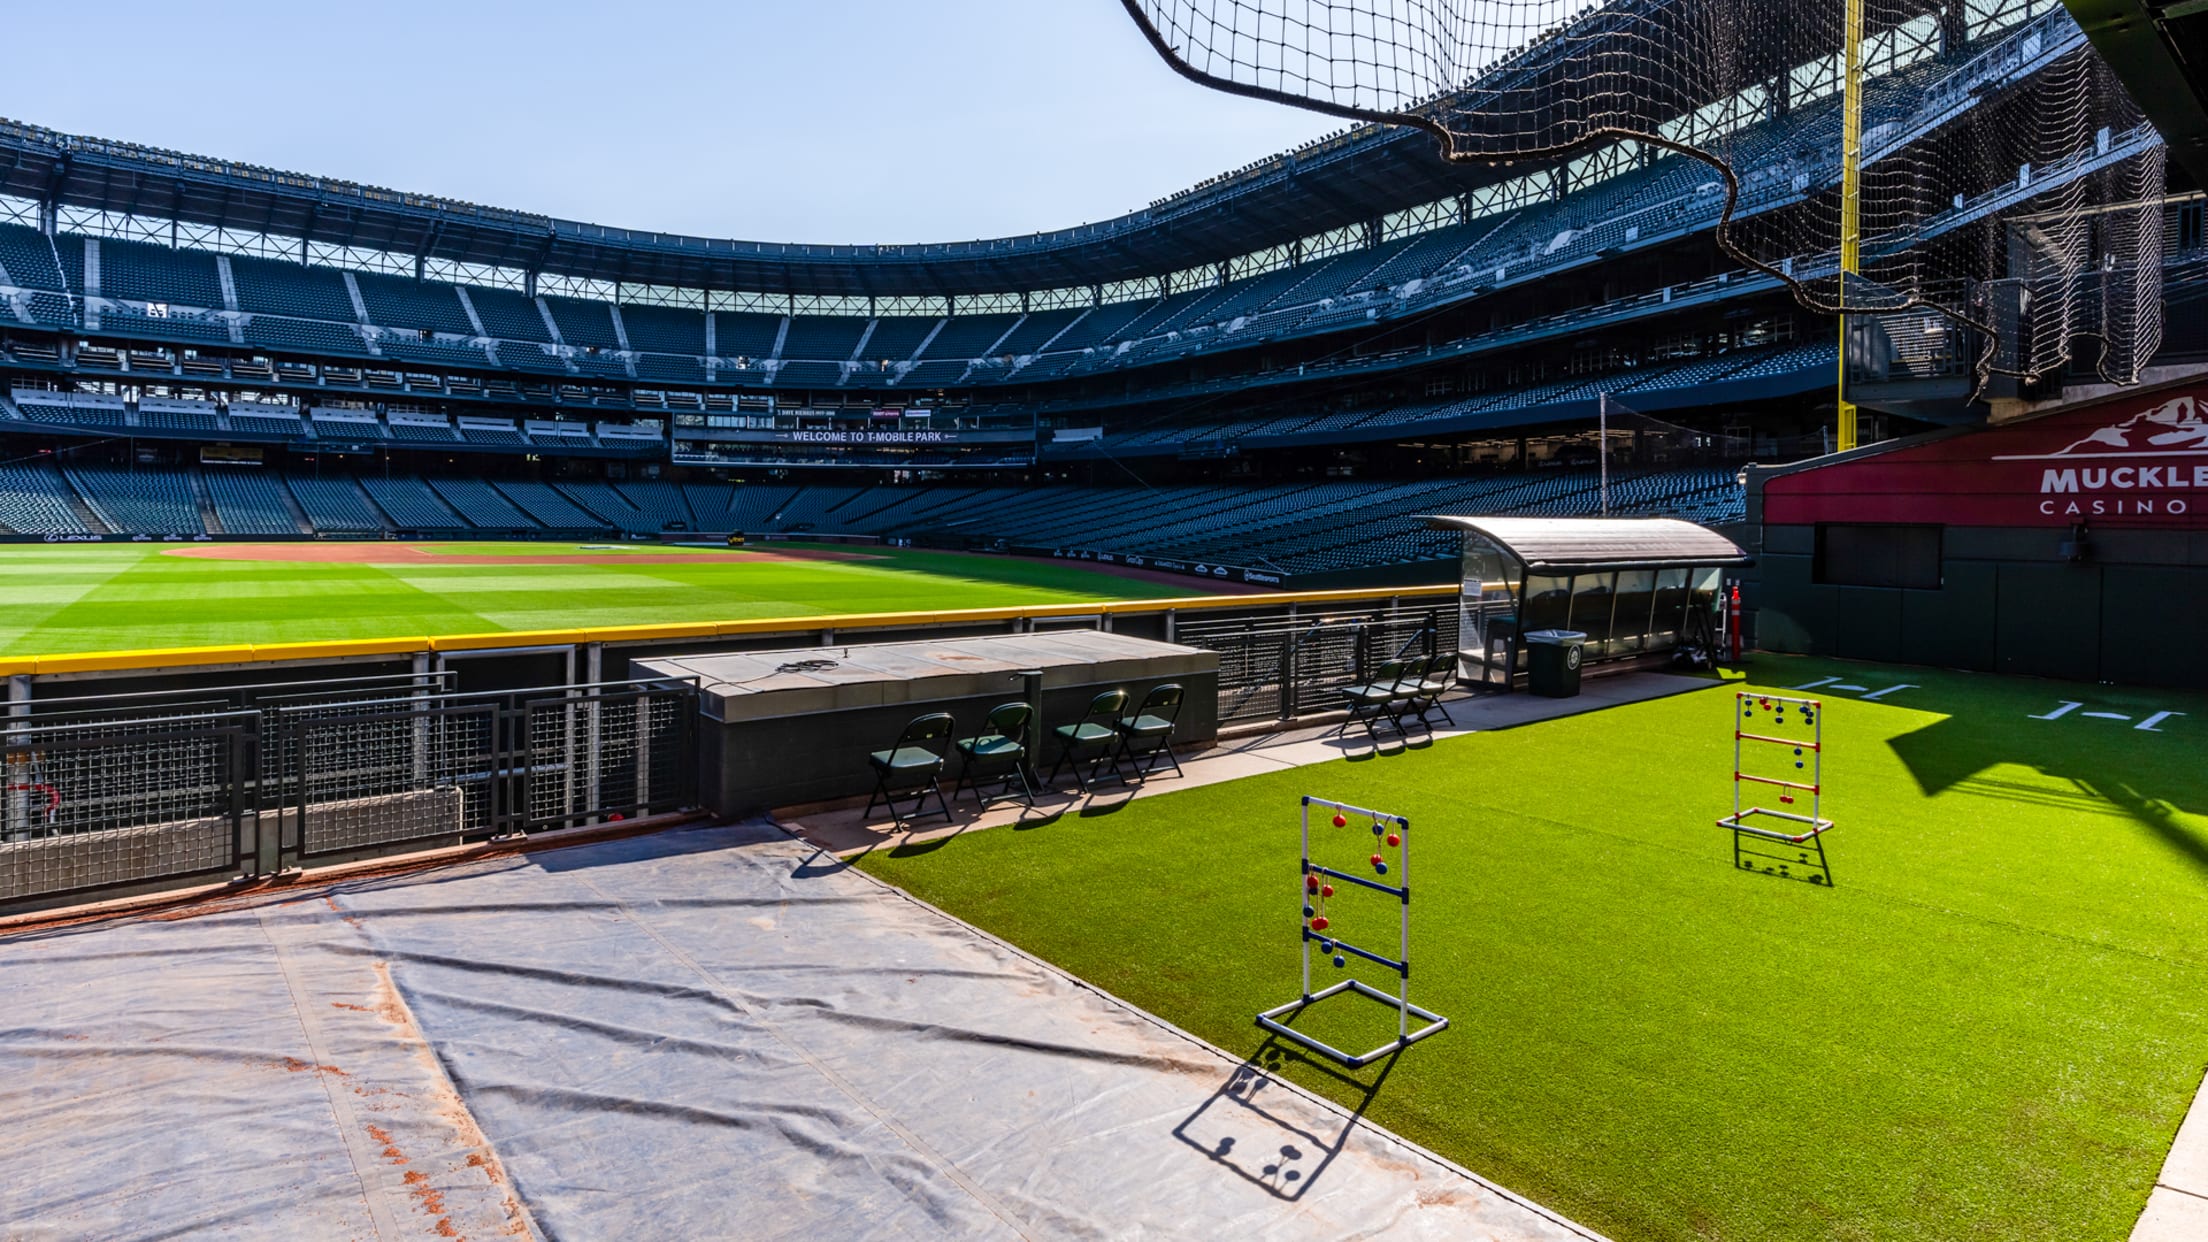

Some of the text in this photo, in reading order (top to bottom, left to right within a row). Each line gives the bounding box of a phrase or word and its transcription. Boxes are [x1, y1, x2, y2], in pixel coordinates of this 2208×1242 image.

[793, 431, 941, 442] WELCOME TO T-MOBILE PARK
[2040, 499, 2187, 515] CASINO
[59, 534, 103, 542] LEXUS
